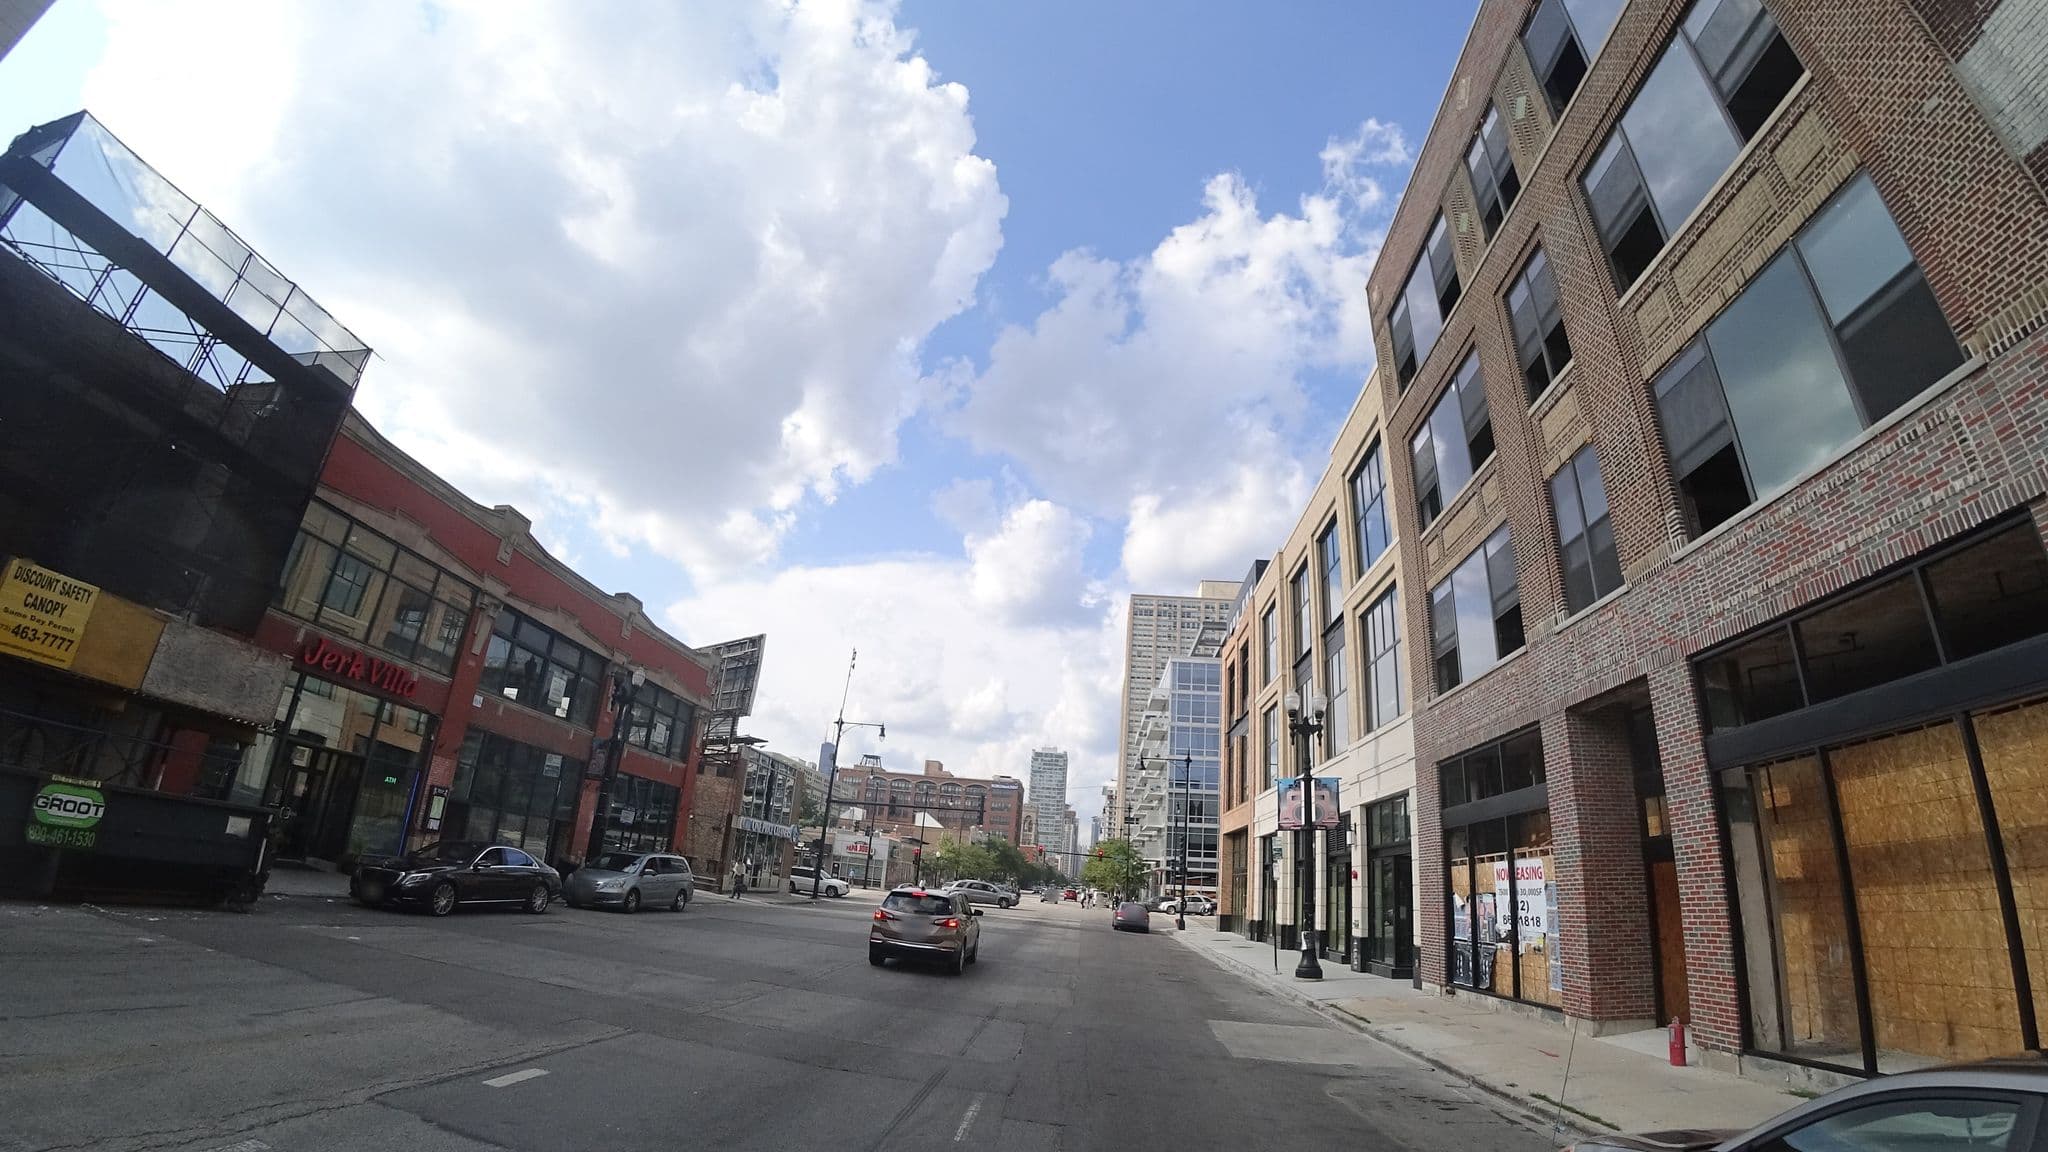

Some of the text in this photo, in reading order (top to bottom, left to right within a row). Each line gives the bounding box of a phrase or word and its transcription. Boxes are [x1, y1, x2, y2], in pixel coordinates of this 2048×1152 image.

[14, 566, 94, 604] DISCOUNT SAFETY
[24, 592, 68, 618] CANOPY
[3, 606, 75, 634] Same Day Permit
[11, 624, 75, 652] 463-7777
[304, 638, 417, 697] Jerk Villa
[36, 795, 105, 816] GROOT
[1515, 866, 1543, 880] EASING
